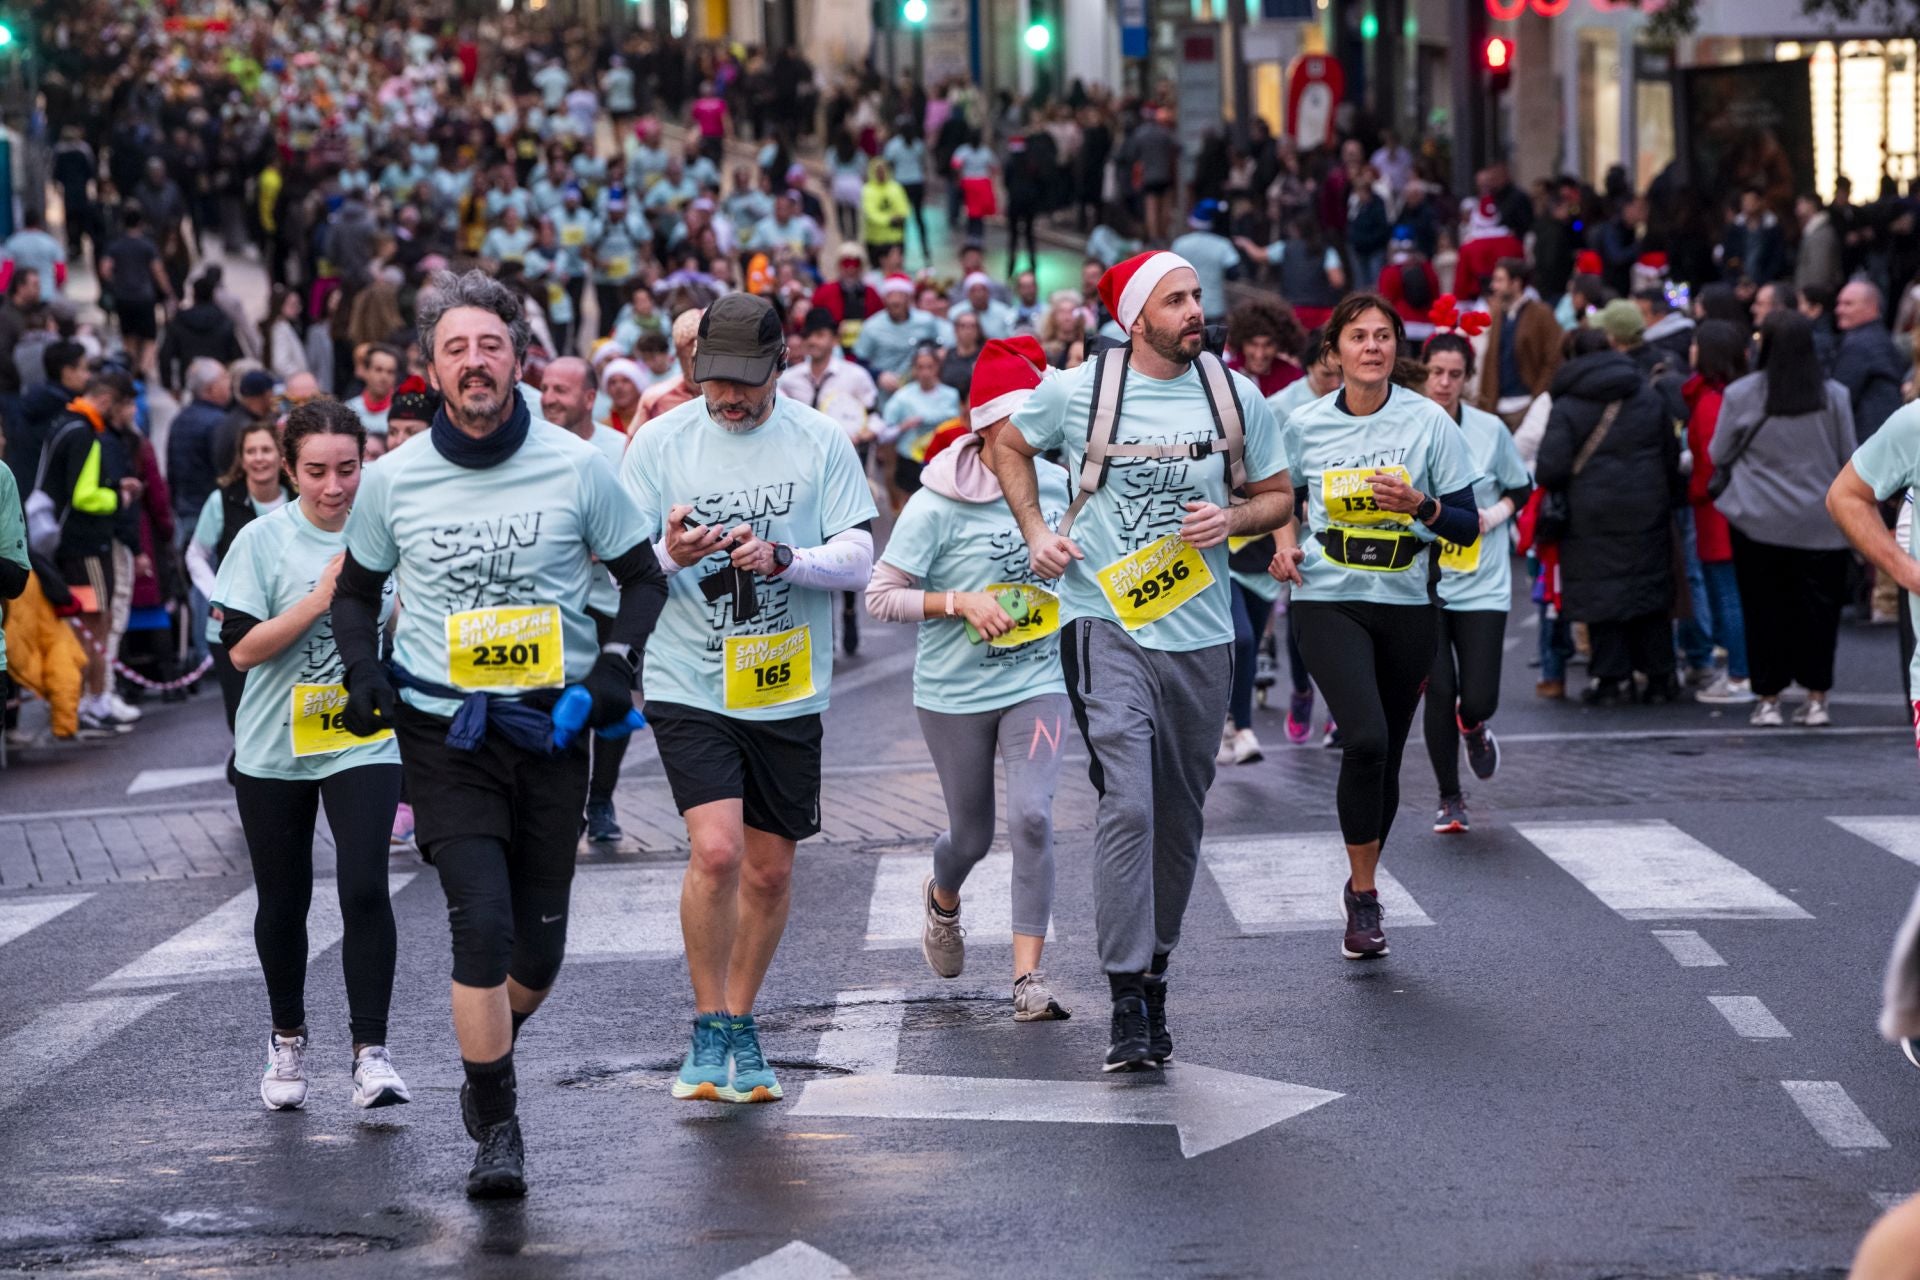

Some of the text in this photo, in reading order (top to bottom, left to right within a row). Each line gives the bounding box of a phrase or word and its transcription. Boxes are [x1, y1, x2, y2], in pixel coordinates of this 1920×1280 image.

[1121, 464, 1195, 499] SIL
[1332, 472, 1360, 488] SAN
[695, 482, 794, 528] SAN
[1342, 496, 1380, 512] 133
[430, 511, 542, 563] SAN
[446, 551, 526, 595] SIL
[1109, 558, 1140, 586] SAN
[1114, 533, 1183, 598] SILVESTRE
[1127, 559, 1190, 609] 2936
[459, 609, 553, 650] SILVESTRE
[460, 612, 498, 634] SAN
[472, 643, 540, 667] 2301
[735, 630, 805, 672] SILVESTRE
[736, 640, 770, 658] SAN
[754, 662, 791, 688] 165
[303, 688, 338, 706] SAN
[303, 695, 349, 718] SILVE
[320, 712, 346, 731] 16
